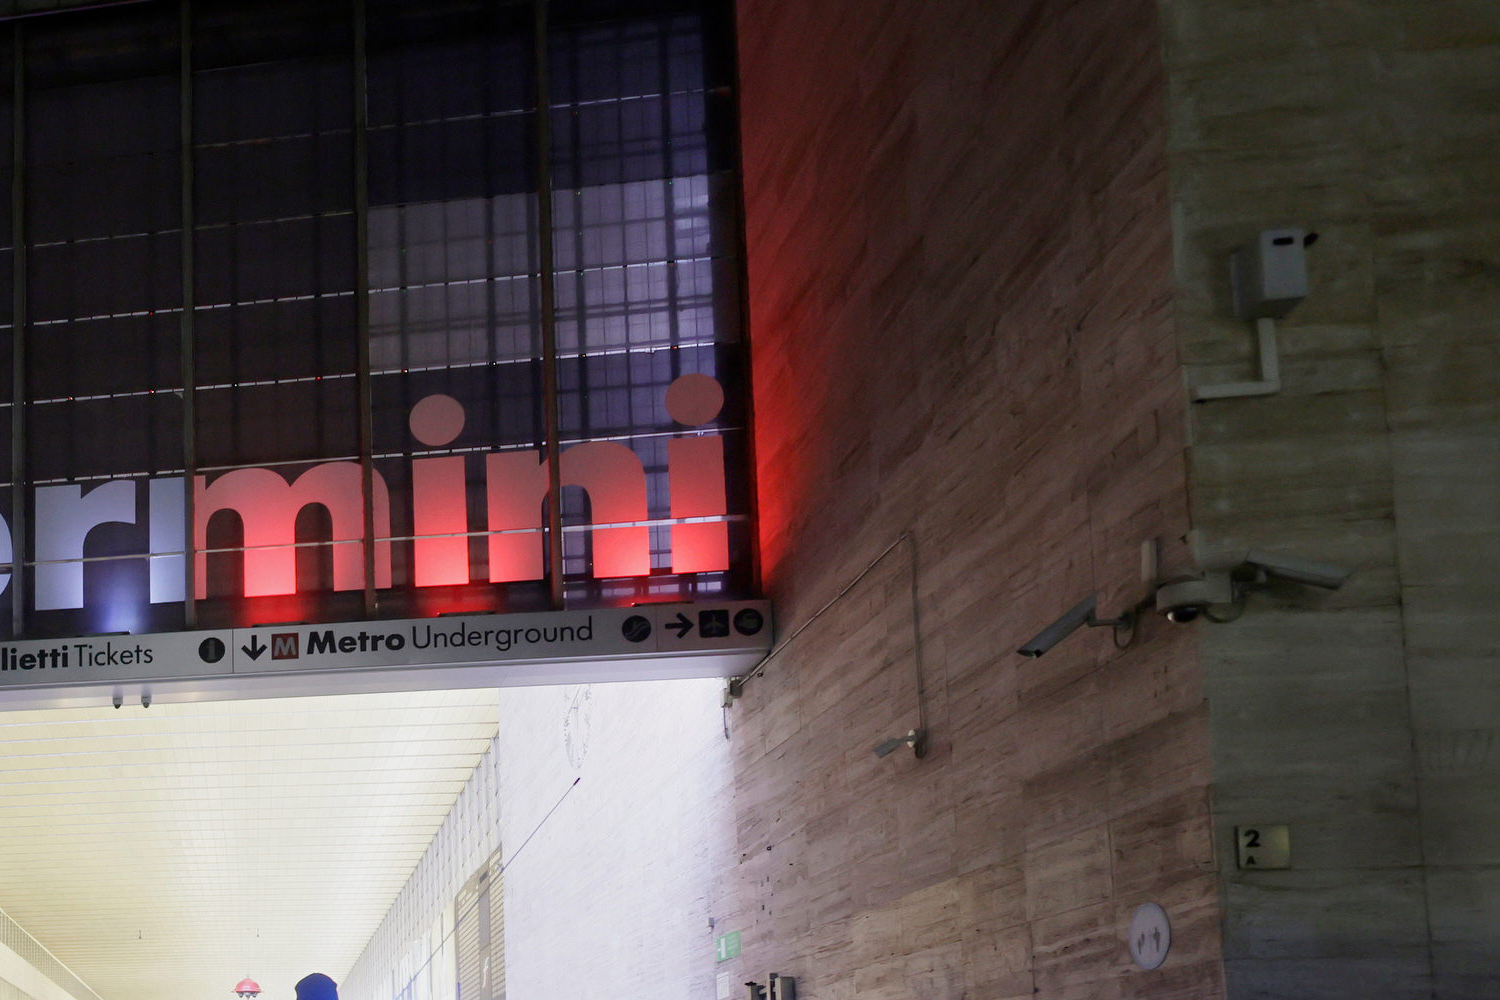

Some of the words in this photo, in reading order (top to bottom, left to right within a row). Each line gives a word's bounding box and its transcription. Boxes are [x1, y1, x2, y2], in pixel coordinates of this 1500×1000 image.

[306, 629, 405, 655] Metro
[412, 616, 593, 651] Underground
[74, 642, 153, 667] Tickets
[1244, 829, 1260, 847] 2
